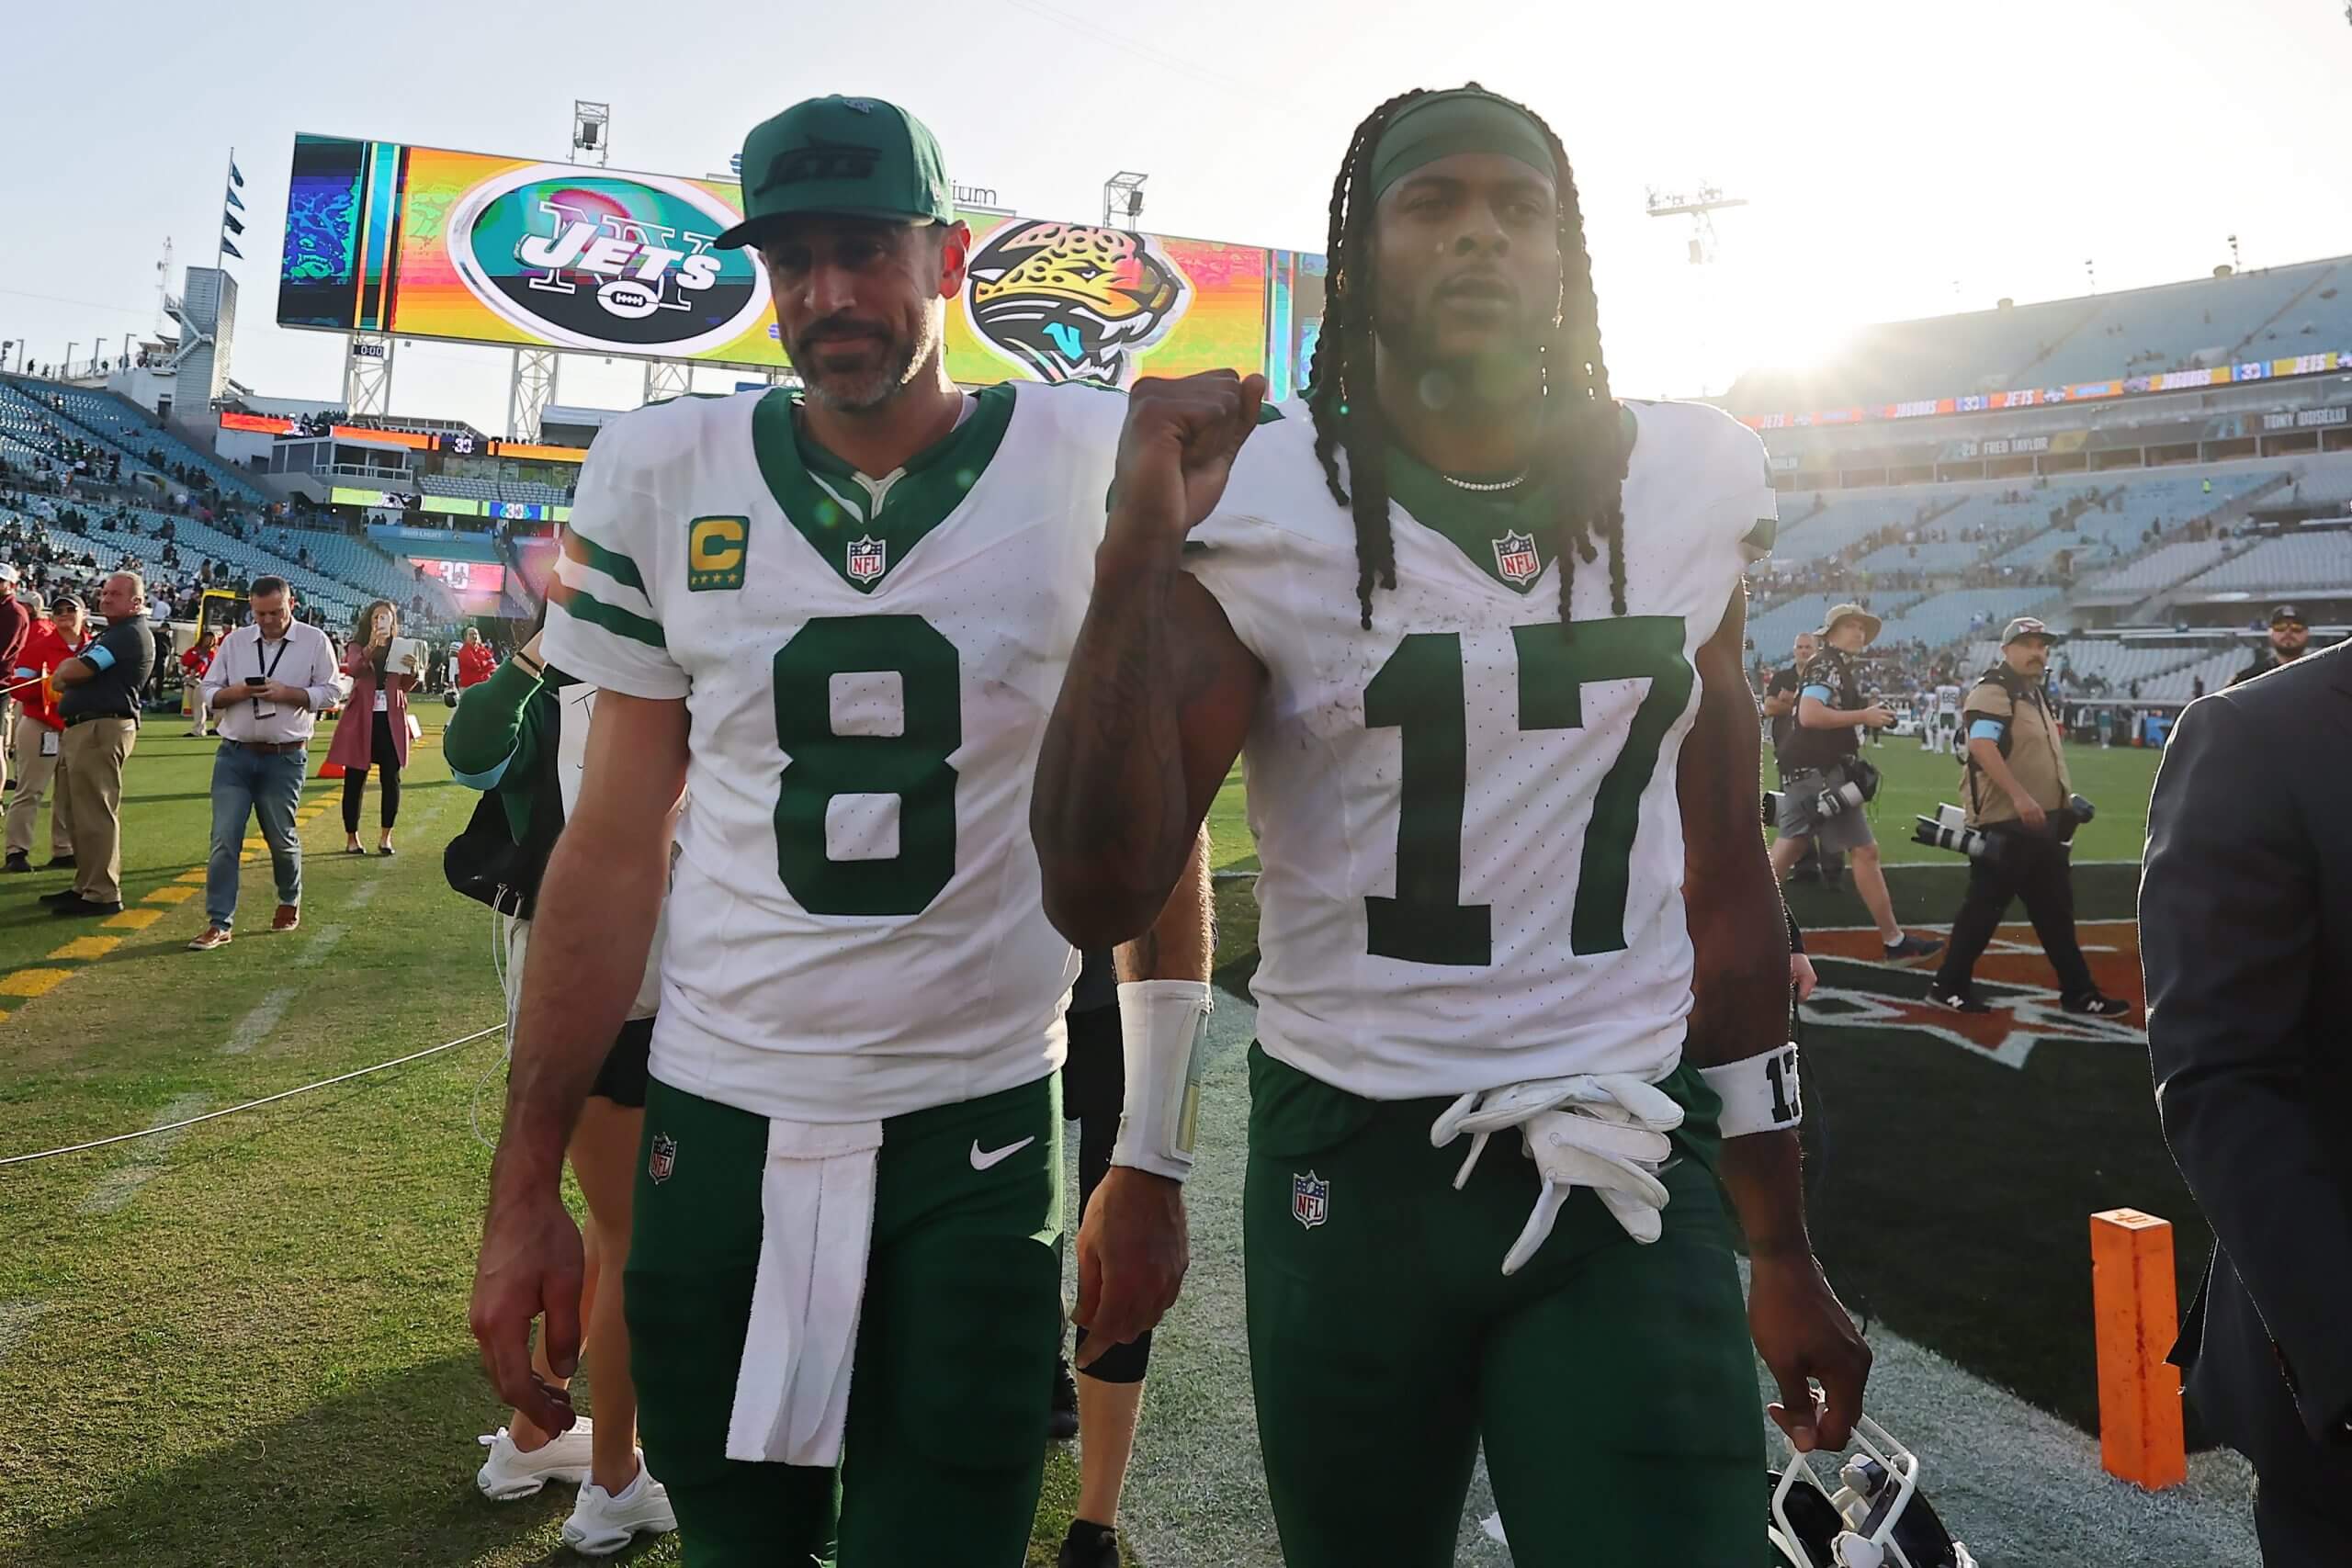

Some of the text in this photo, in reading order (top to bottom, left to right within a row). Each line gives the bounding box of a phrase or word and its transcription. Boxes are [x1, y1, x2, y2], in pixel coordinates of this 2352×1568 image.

[947, 179, 997, 207] ium
[513, 220, 722, 291] JETS
[360, 344, 383, 356] 0:00
[2005, 389, 2034, 407] JETS
[690, 520, 743, 571] C
[853, 557, 879, 574] NFL
[1504, 553, 1534, 574] NFL
[774, 614, 962, 917] 8
[1363, 615, 1694, 966] 17
[1297, 1195, 1322, 1219] NFL
